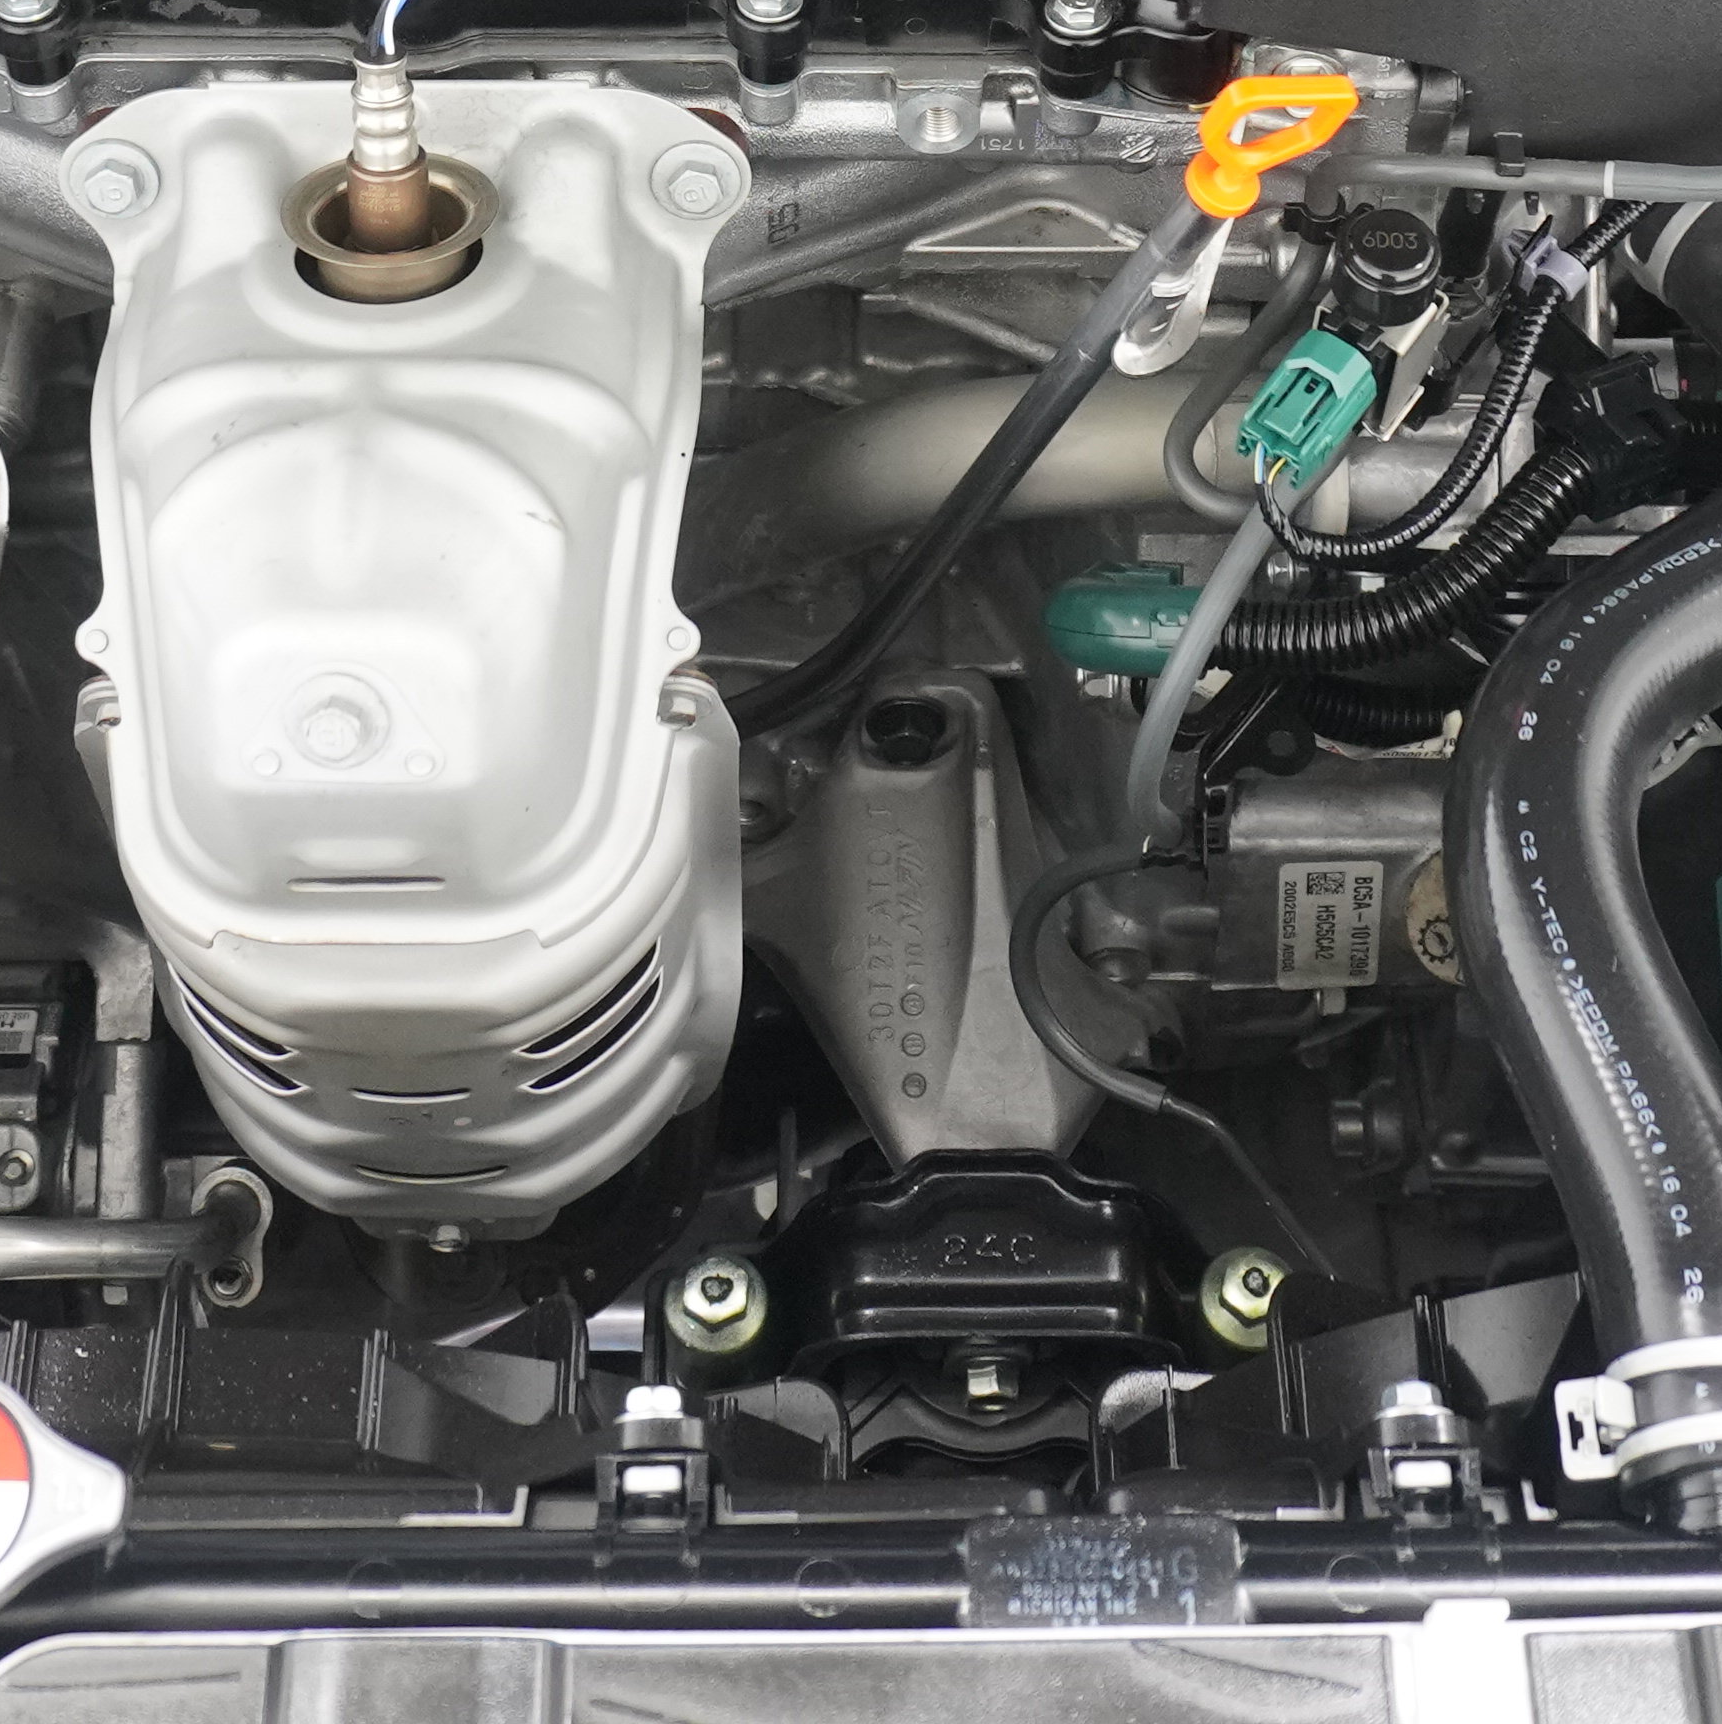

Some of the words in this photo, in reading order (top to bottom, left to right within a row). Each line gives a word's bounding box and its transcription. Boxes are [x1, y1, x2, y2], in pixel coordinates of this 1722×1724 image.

[979, 138, 1026, 151] 1751
[1360, 228, 1419, 251] 6D03
[10, 1012, 30, 1020] USE
[1657, 1163, 1682, 1195] 16
[1668, 1202, 1692, 1239] 04
[1681, 1266, 1705, 1304] 26
